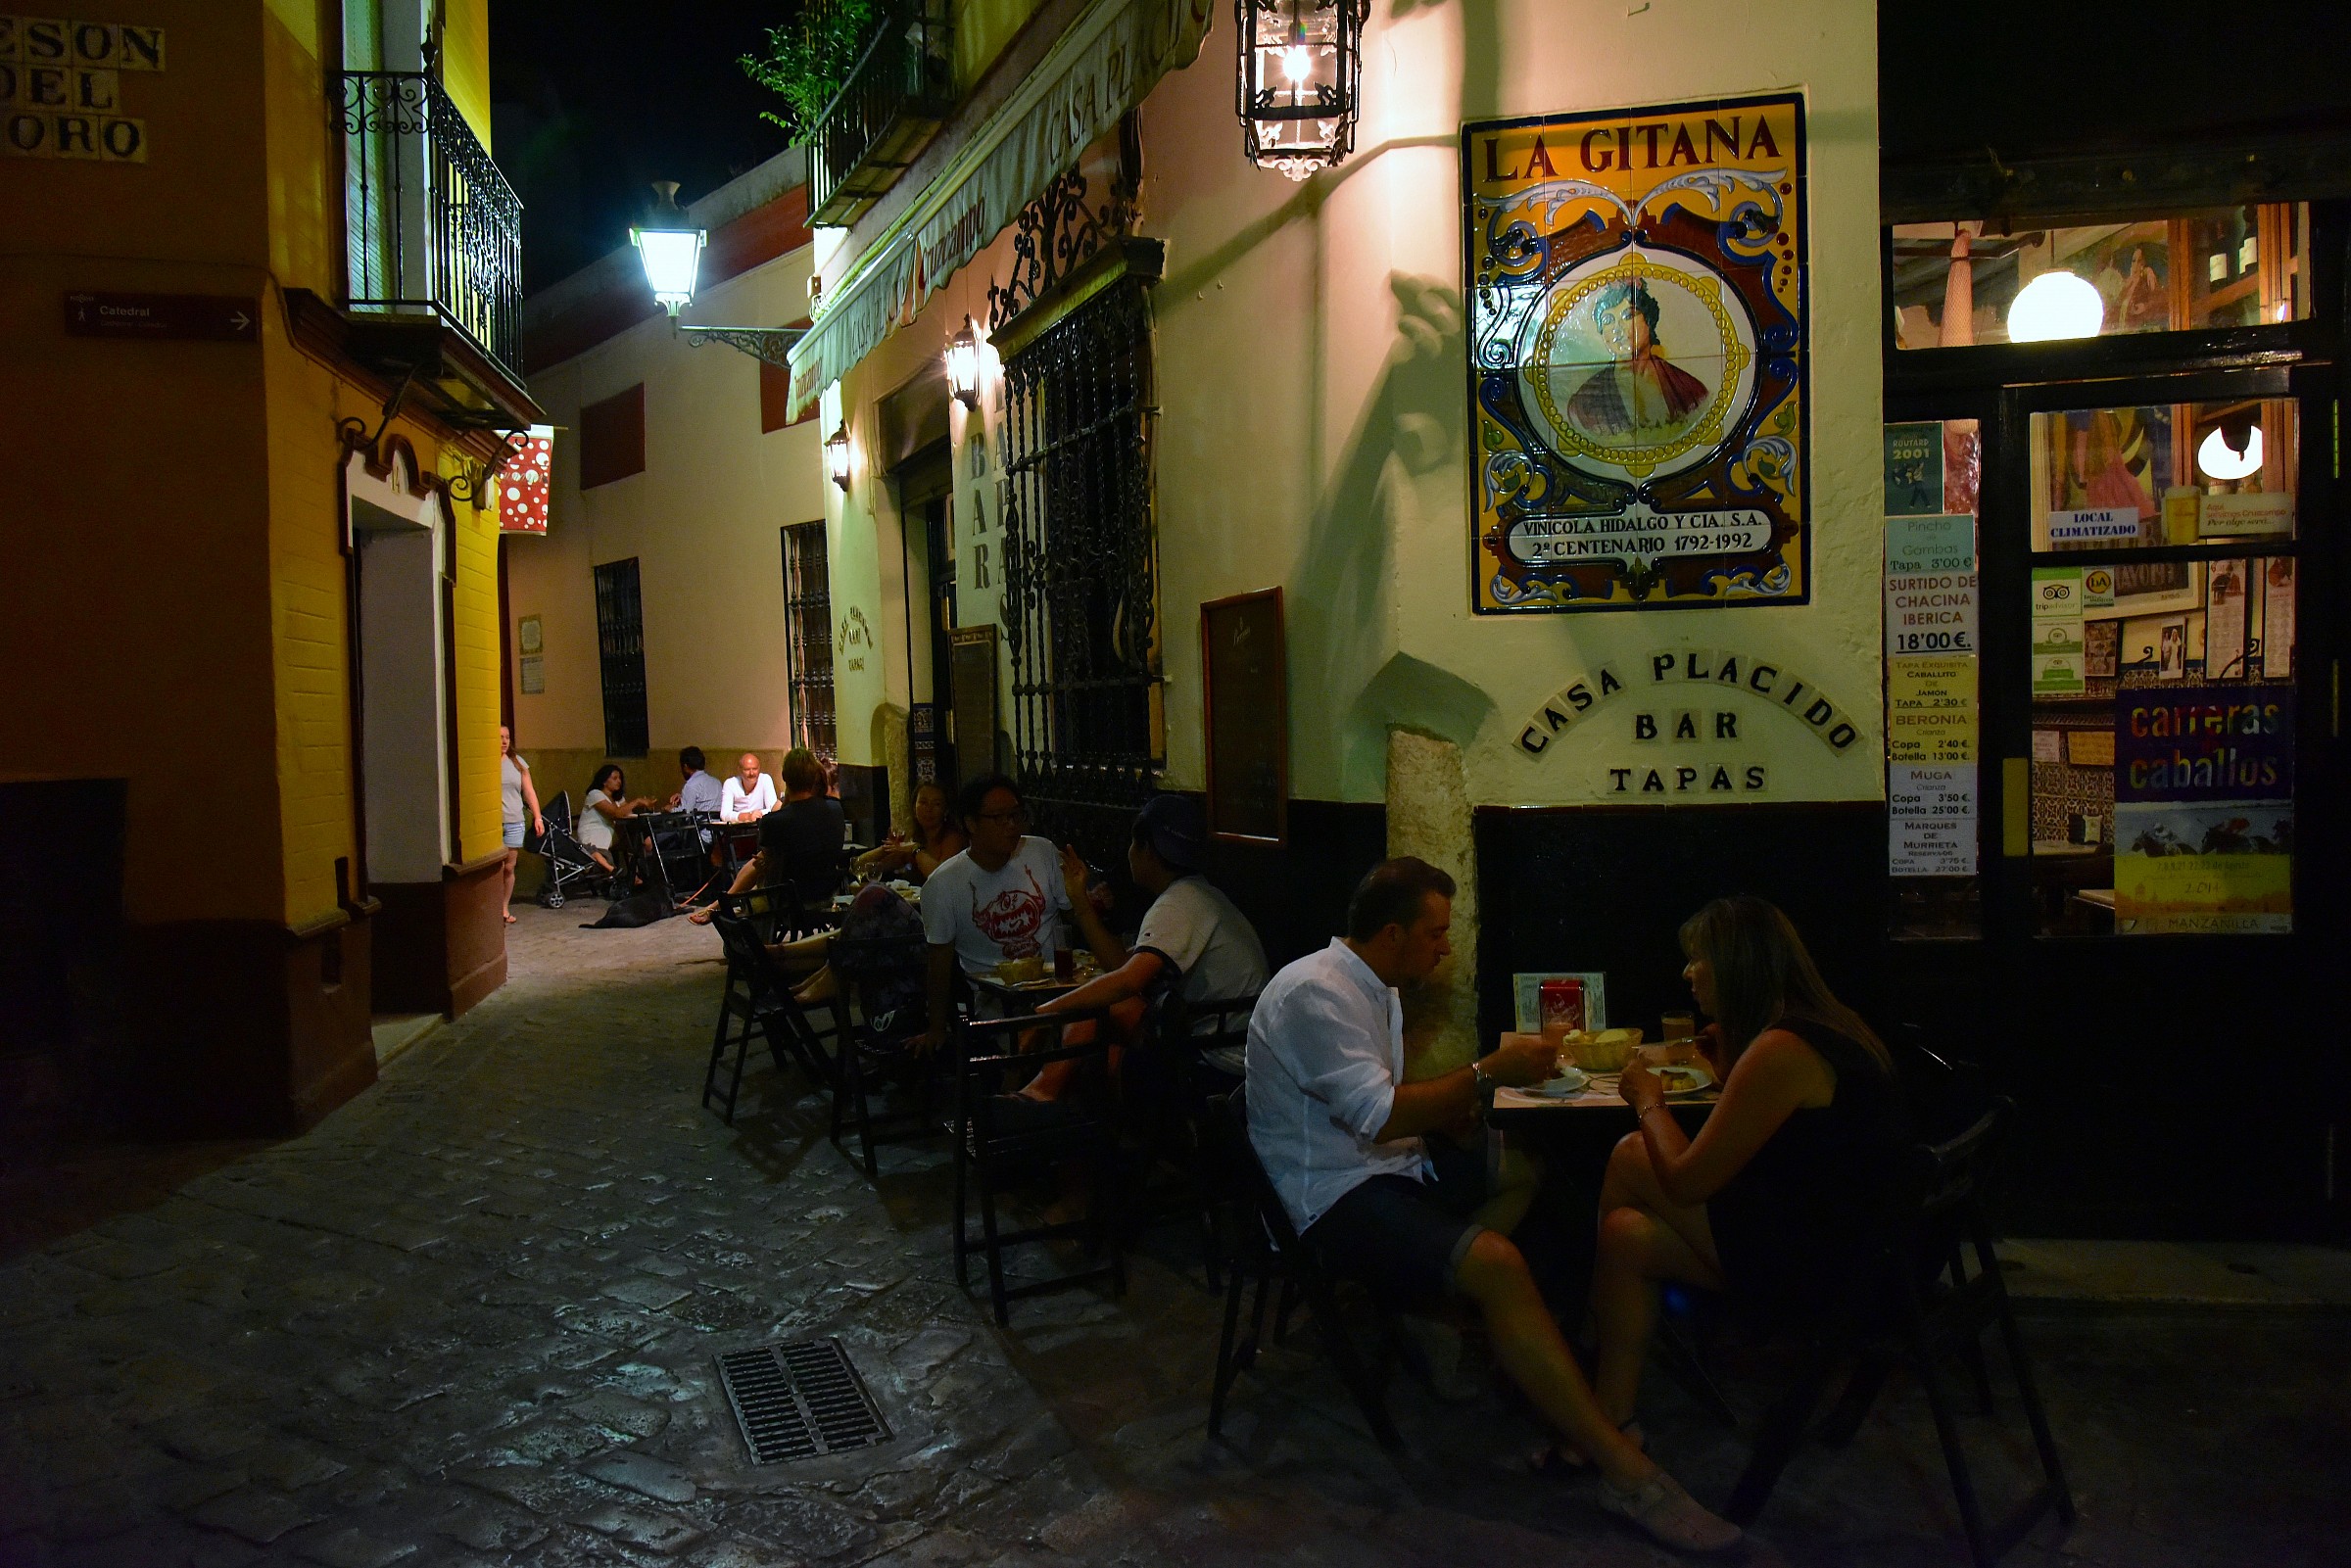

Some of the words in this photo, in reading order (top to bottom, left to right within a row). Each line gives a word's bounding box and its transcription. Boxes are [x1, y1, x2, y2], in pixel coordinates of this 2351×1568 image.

[1482, 134, 1559, 183] LA
[1580, 114, 1781, 172] GITANA
[99, 305, 150, 317] Catedral
[1893, 438, 1929, 448] ROUTARD
[1893, 449, 1930, 460] 2001
[971, 431, 990, 590] BAR
[1523, 517, 1595, 536] VINICOLA
[1601, 515, 1668, 533] HIDALGO
[1674, 515, 1685, 530] Y
[1730, 511, 1762, 527] S.A.
[2074, 512, 2113, 523] LOCAL
[1907, 520, 1951, 532] Pincho
[2050, 524, 2135, 538] CLIMATIZADO
[1555, 538, 1665, 556] CENTENARIO
[1674, 533, 1752, 551] 1792-1992
[1902, 544, 1958, 556] Gambas
[1891, 560, 1921, 572] Tapa
[1889, 577, 1952, 592] SURTIDO
[1958, 576, 1977, 588] DE
[1895, 594, 1970, 608] CHACINA
[1903, 611, 1963, 625] IBERICA
[1520, 669, 1621, 753] CASA
[1653, 652, 1856, 748] PLACIDO
[1635, 713, 1737, 739] BAR
[1895, 715, 1968, 726] BERONIA
[2130, 704, 2279, 737] carreras
[1892, 739, 1921, 750] Copa
[1892, 752, 1927, 761] Botella
[2130, 747, 2278, 790] caballos
[1609, 766, 1765, 791] TAPAS
[1910, 771, 1952, 781] MUGA
[1893, 794, 1921, 804] Copa
[1892, 806, 1927, 815] Botella
[2168, 918, 2259, 929] MANZANILLA
